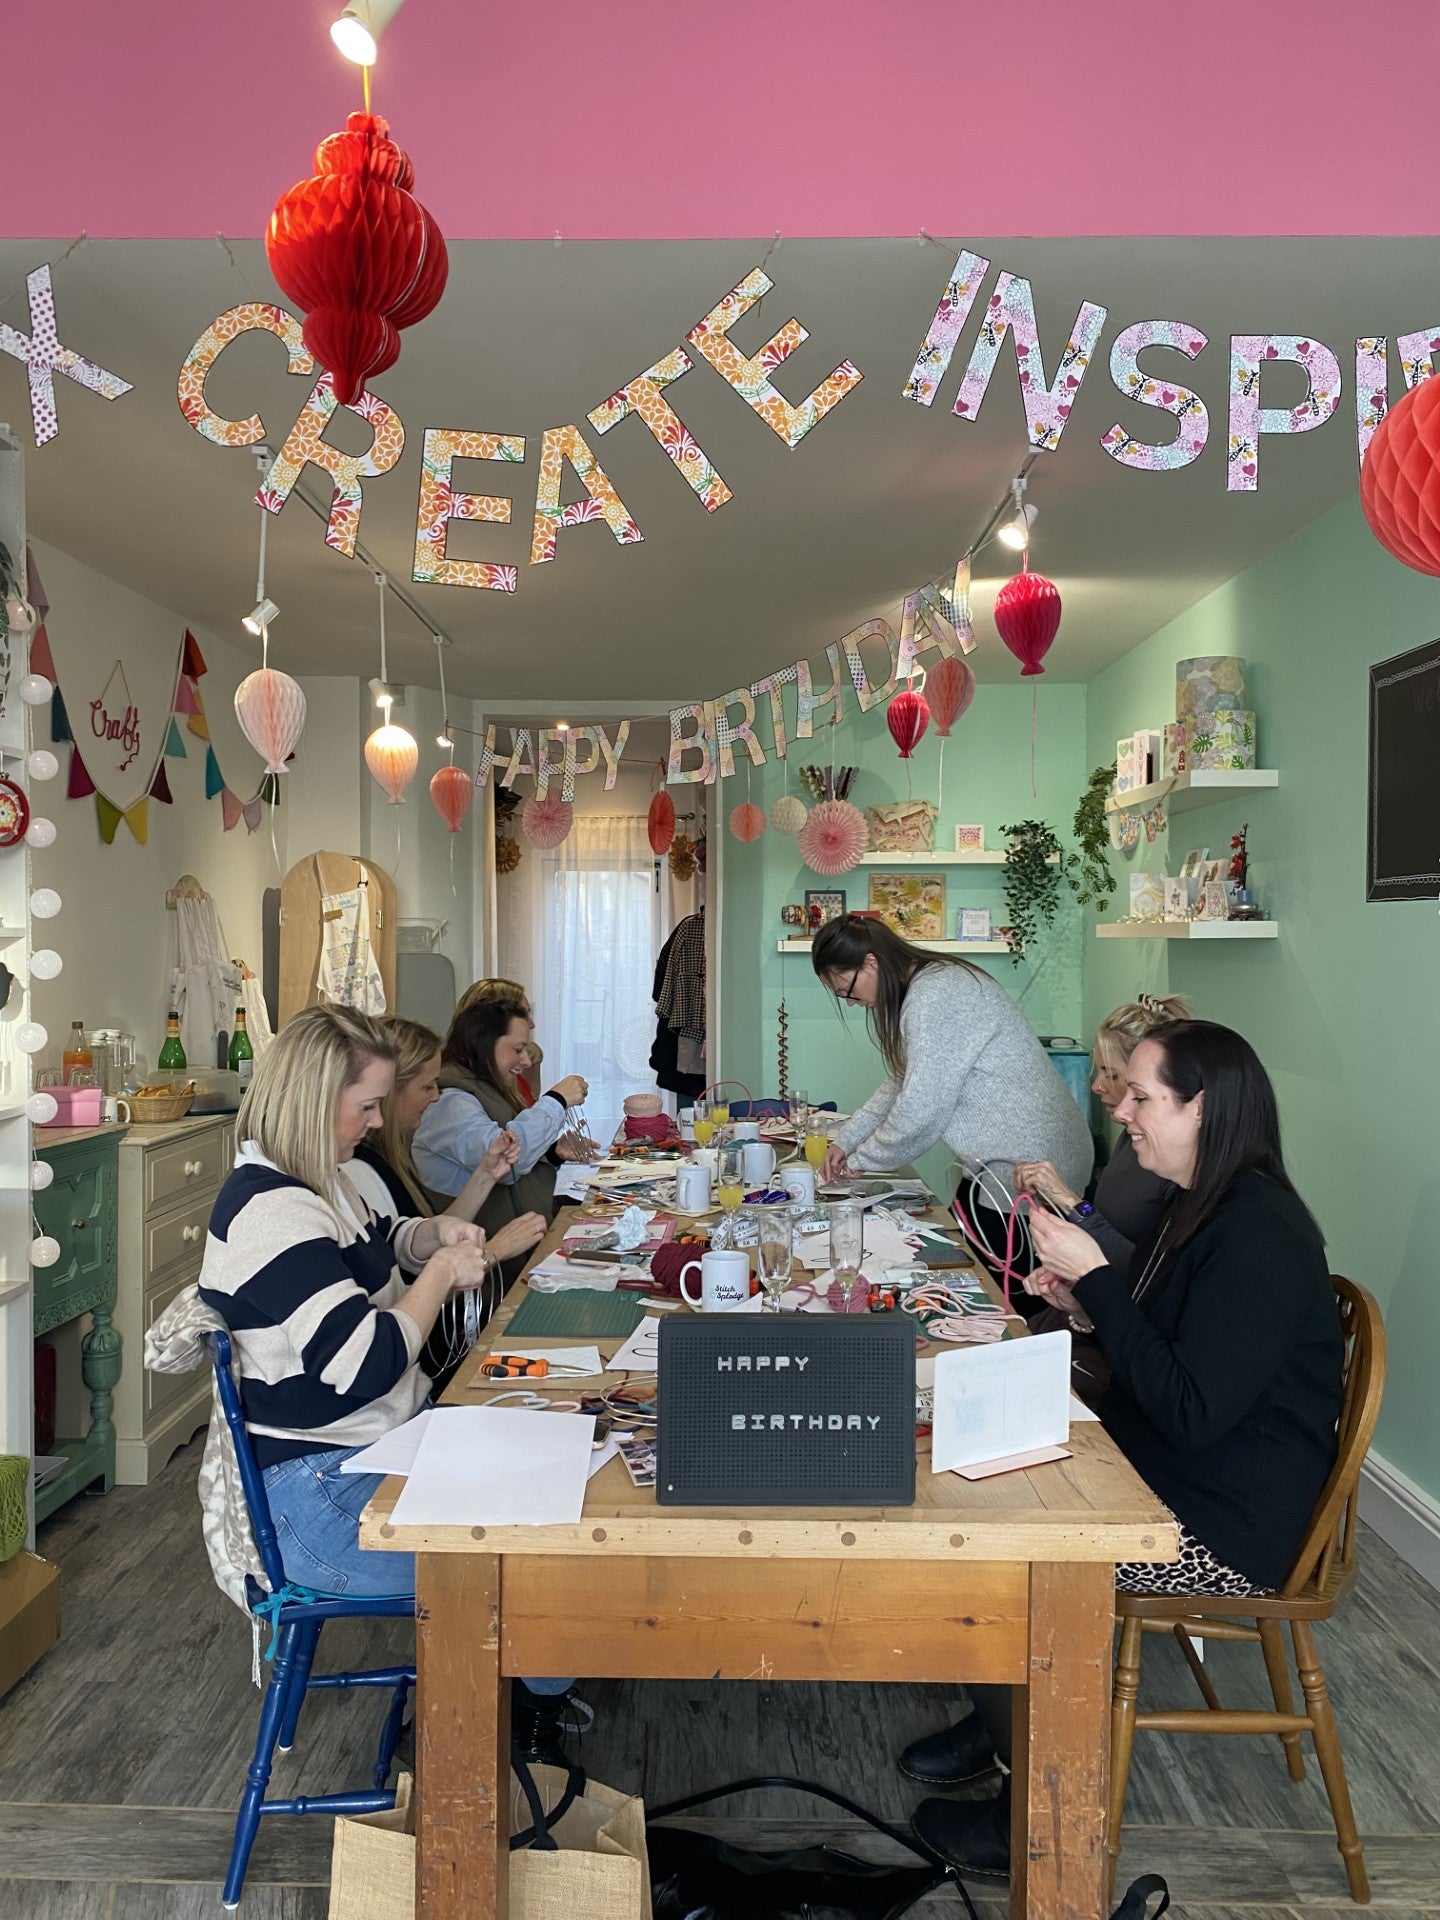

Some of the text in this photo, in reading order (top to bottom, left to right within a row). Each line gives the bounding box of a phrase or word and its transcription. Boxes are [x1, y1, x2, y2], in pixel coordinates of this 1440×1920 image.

[177, 266, 866, 594] CREATE
[475, 553, 978, 802] HAPPY BIRTHDAY
[714, 1284, 736, 1293] Stitch
[716, 1292, 745, 1301] Splodge
[717, 1356, 809, 1371] HAPPY
[731, 1414, 881, 1430] BIRTHDAY
